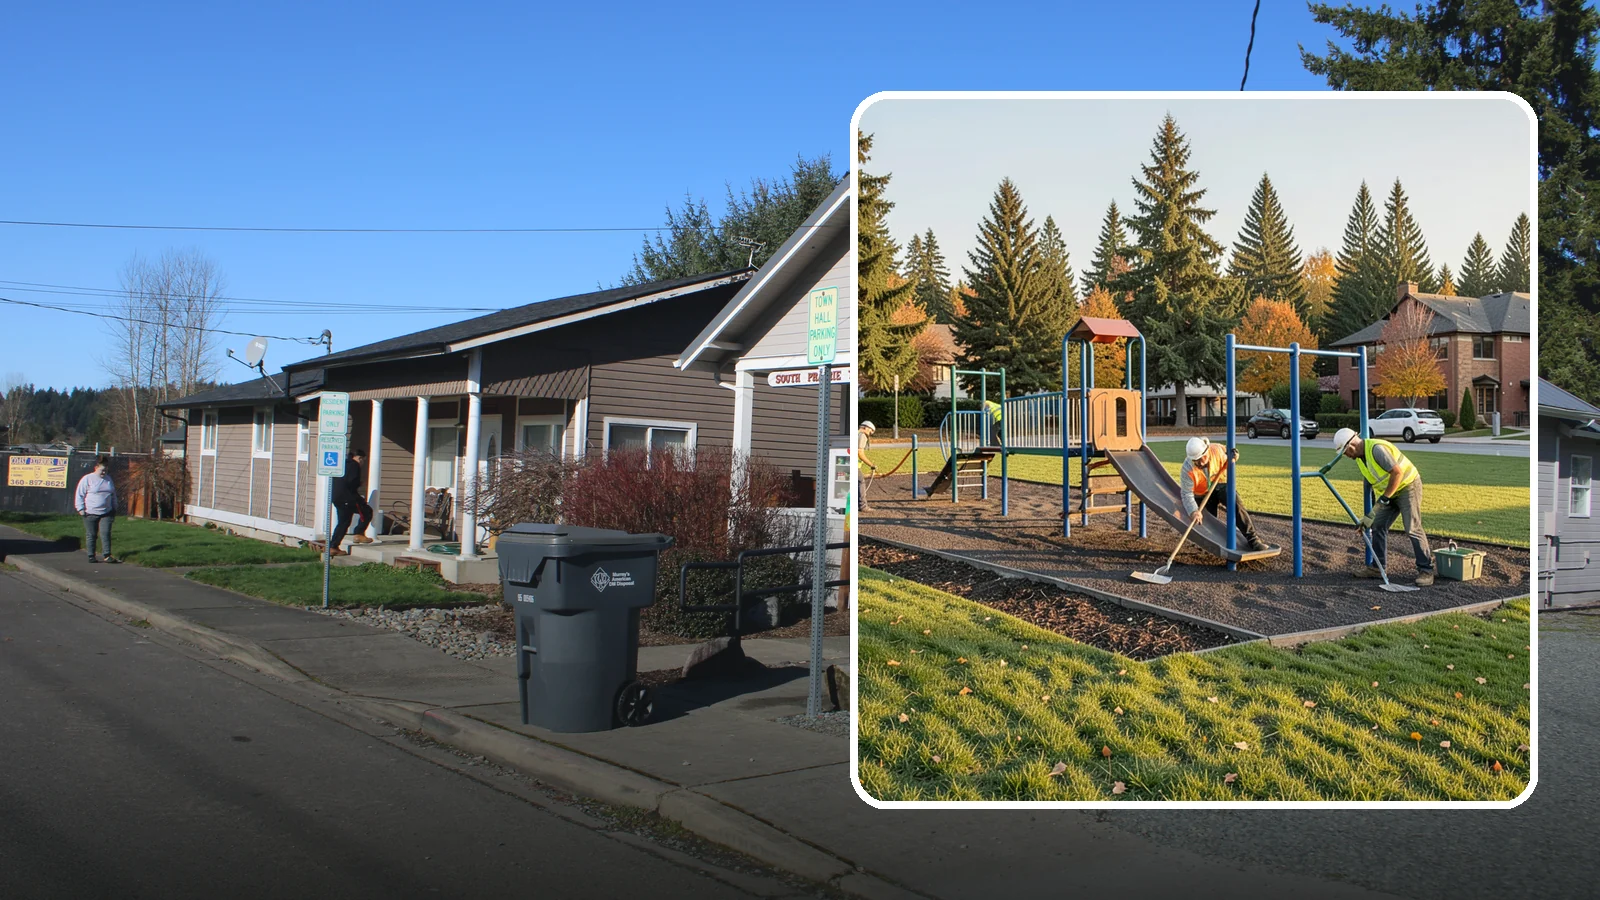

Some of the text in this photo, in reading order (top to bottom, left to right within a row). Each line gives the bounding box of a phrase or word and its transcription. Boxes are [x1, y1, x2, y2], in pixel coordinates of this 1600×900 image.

[815, 294, 833, 308] TOWN
[814, 312, 831, 324] HALL
[809, 327, 836, 340] PARKING
[813, 344, 831, 358] ONLY
[775, 373, 800, 384] SOUTH
[323, 409, 345, 417] PARKING
